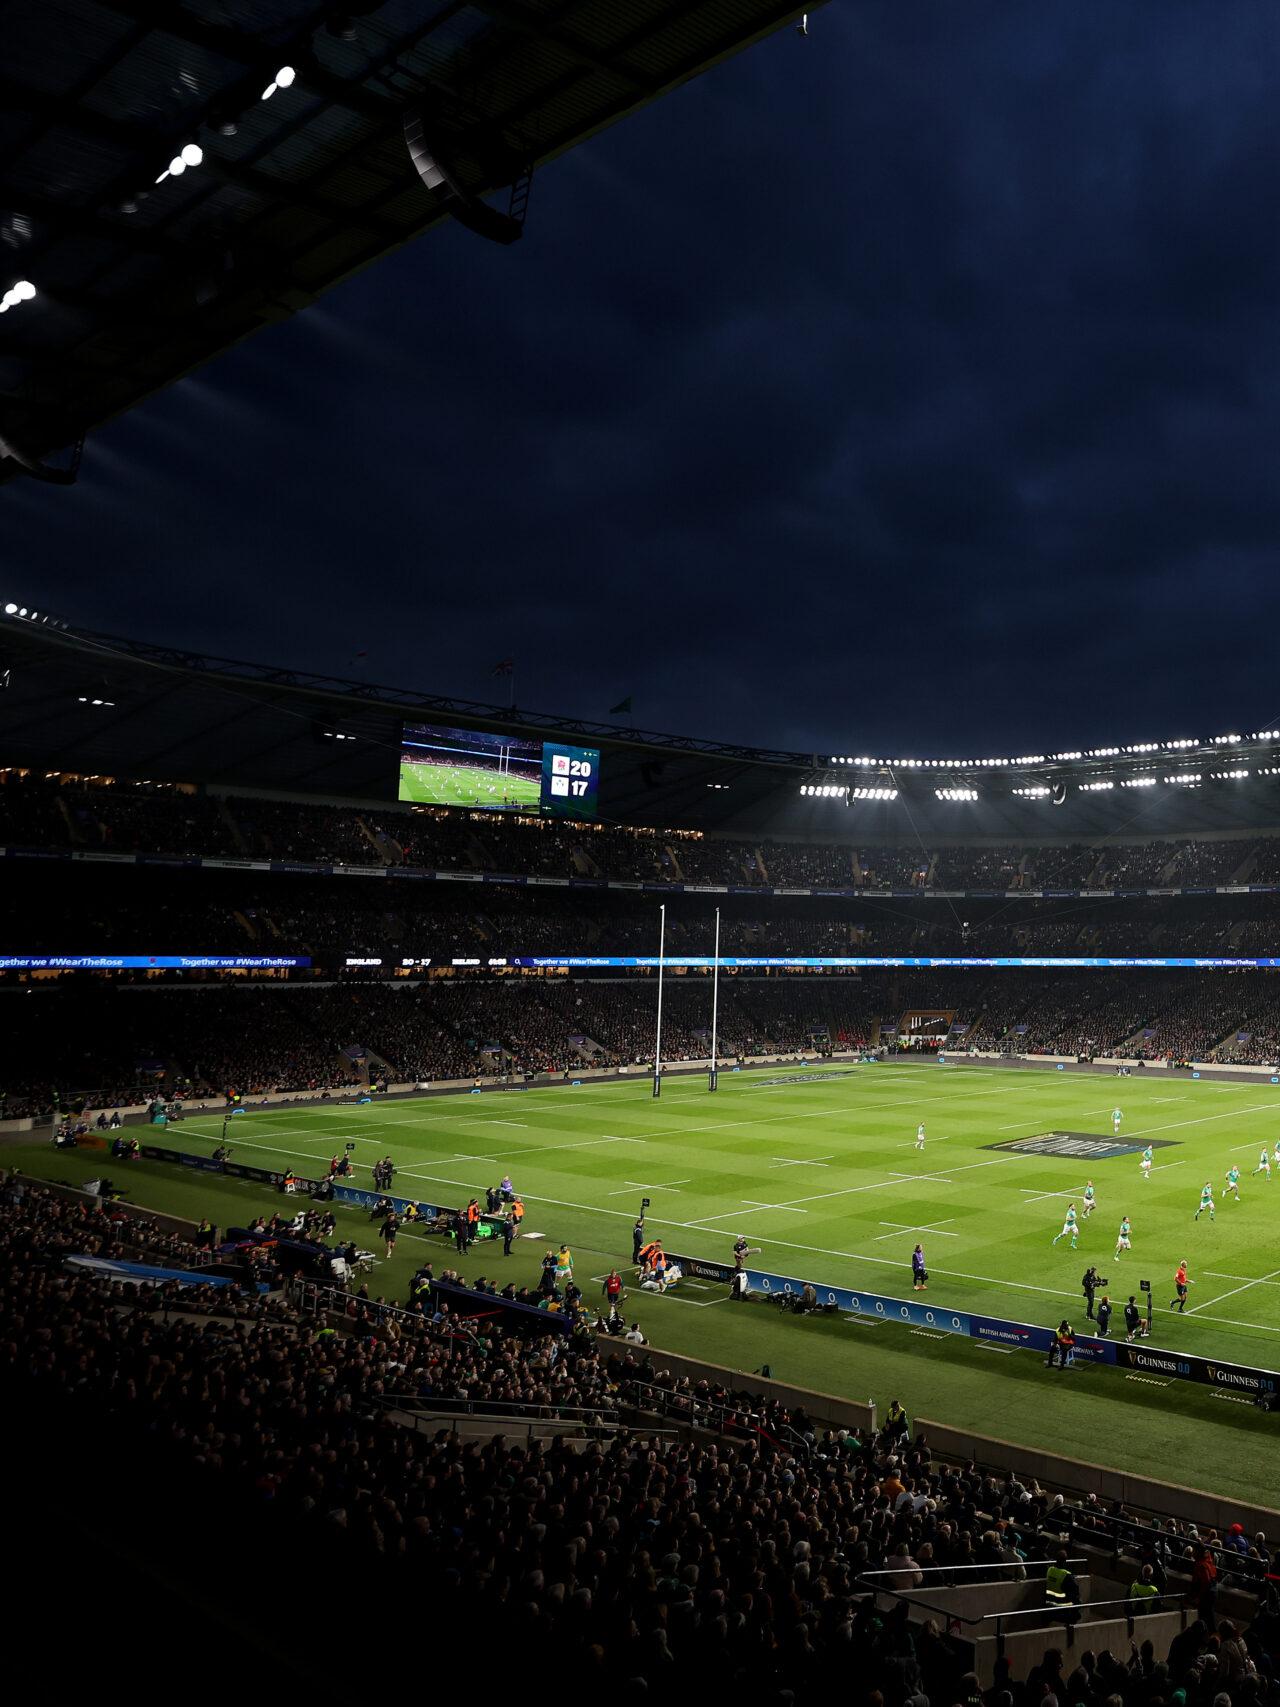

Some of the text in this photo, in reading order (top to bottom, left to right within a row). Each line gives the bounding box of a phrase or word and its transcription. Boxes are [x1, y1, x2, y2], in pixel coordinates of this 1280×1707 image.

[570, 760, 591, 777] 20
[572, 780, 589, 796] 17
[31, 959, 47, 967] we
[49, 958, 123, 967] #WearTheRose
[181, 958, 297, 968] Together we #WearTheRose
[346, 958, 382, 966] ENGLAND
[402, 958, 415, 966] 20
[421, 958, 432, 967] 17
[452, 958, 481, 966] IRELAND
[532, 958, 560, 967] Together
[570, 958, 610, 966] #WearTheRose
[736, 958, 758, 966] Together
[696, 1265, 720, 1278] GUINNESS
[851, 1297, 861, 1311] O2
[875, 1302, 885, 1315] O2
[901, 1307, 911, 1320] O2
[926, 1311, 936, 1325] O2
[952, 1317, 962, 1331] O2
[979, 1327, 1020, 1341] BRITISH AIRWAYS
[1072, 1346, 1094, 1356] AIRWAYS
[1137, 1354, 1190, 1374] GUINNESS 0.0
[1216, 1370, 1259, 1388] GUINNESS
